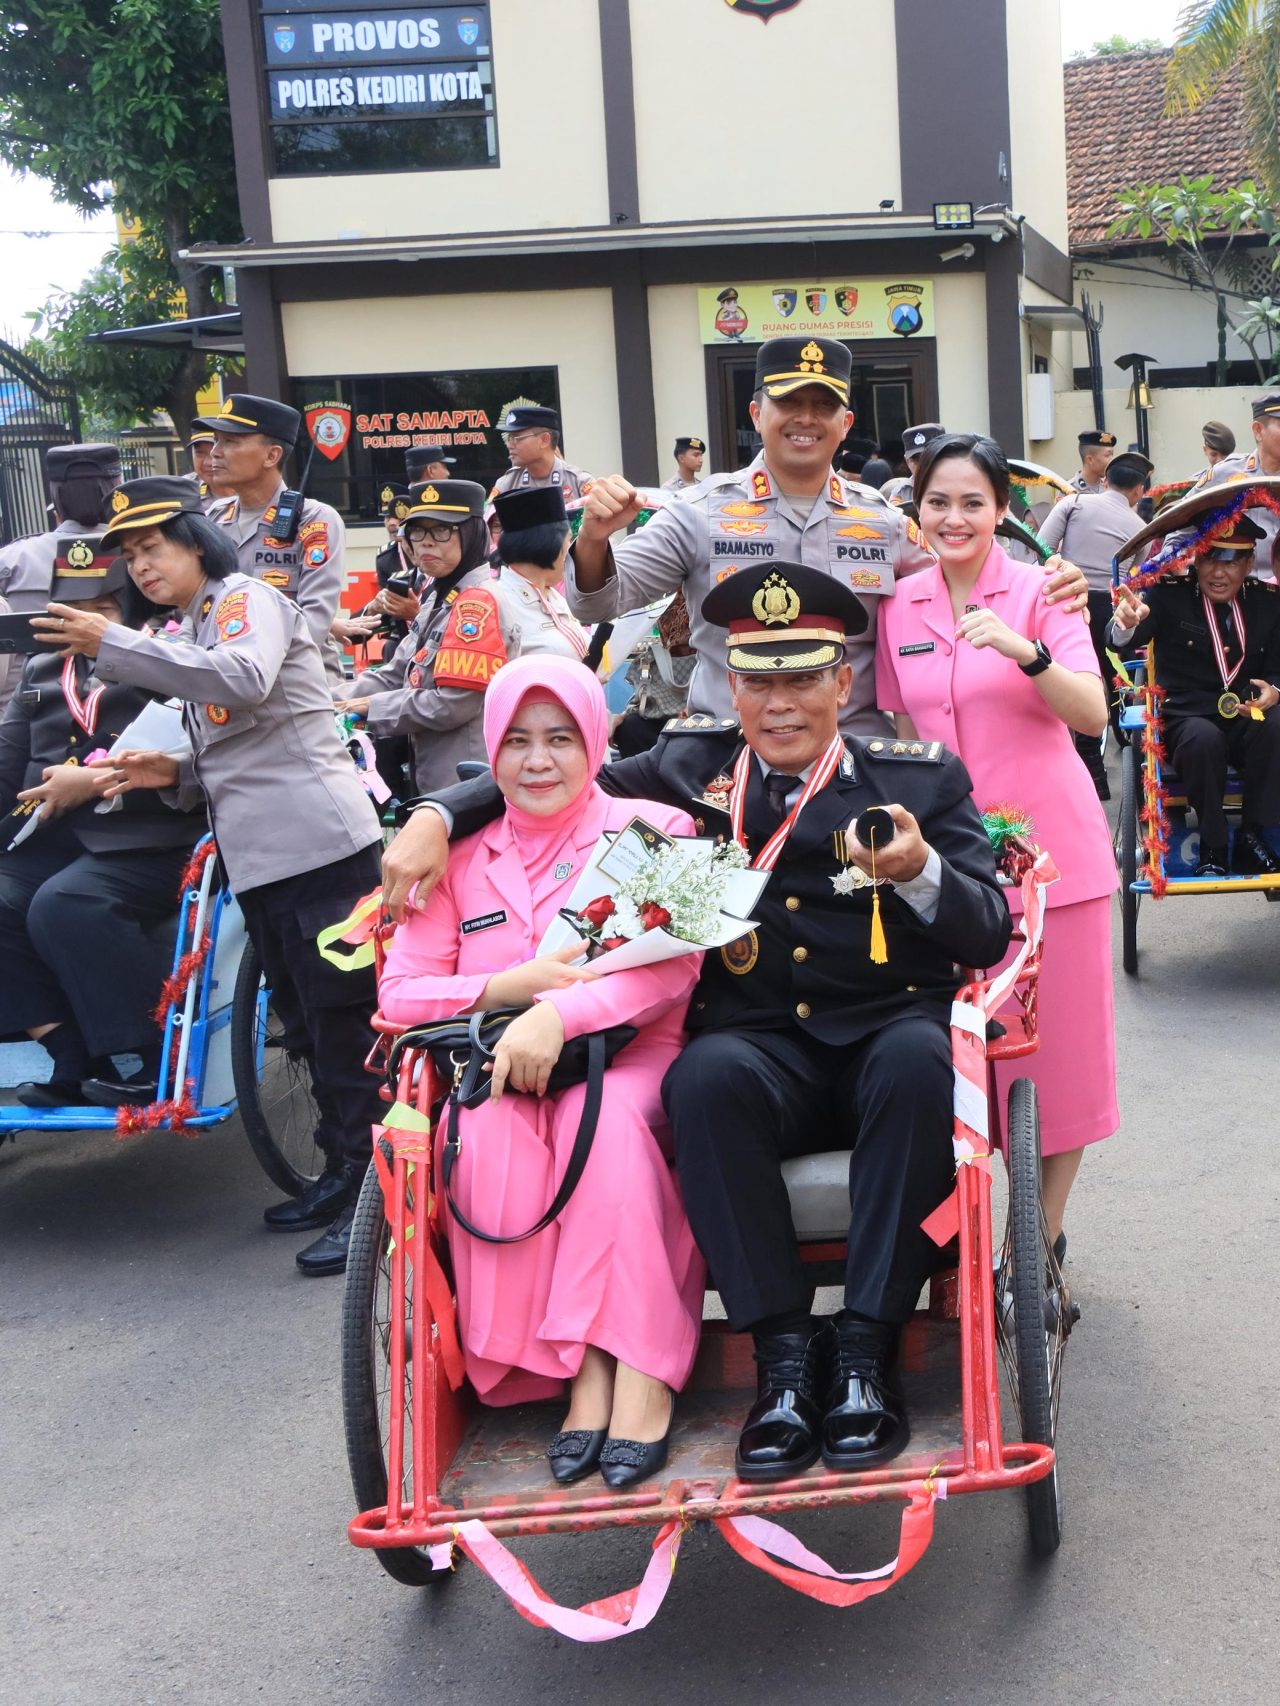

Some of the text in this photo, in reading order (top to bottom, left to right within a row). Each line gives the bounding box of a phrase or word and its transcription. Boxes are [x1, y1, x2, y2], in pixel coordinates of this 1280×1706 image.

[312, 18, 441, 52] PROVOS
[278, 71, 484, 108] POLRES KEDIRI KOTA
[886, 284, 923, 295] JAWA TIMUR
[762, 320, 873, 332] RUANG DUMAS PRESISI
[356, 410, 490, 432] SAT SAMAPTA
[363, 432, 487, 449] POLRES KEDIRI KOTA
[714, 540, 774, 557] BRAMASTYO
[837, 545, 886, 561] POLRI
[255, 551, 298, 565] POLRI
[434, 648, 504, 682] AWAS
